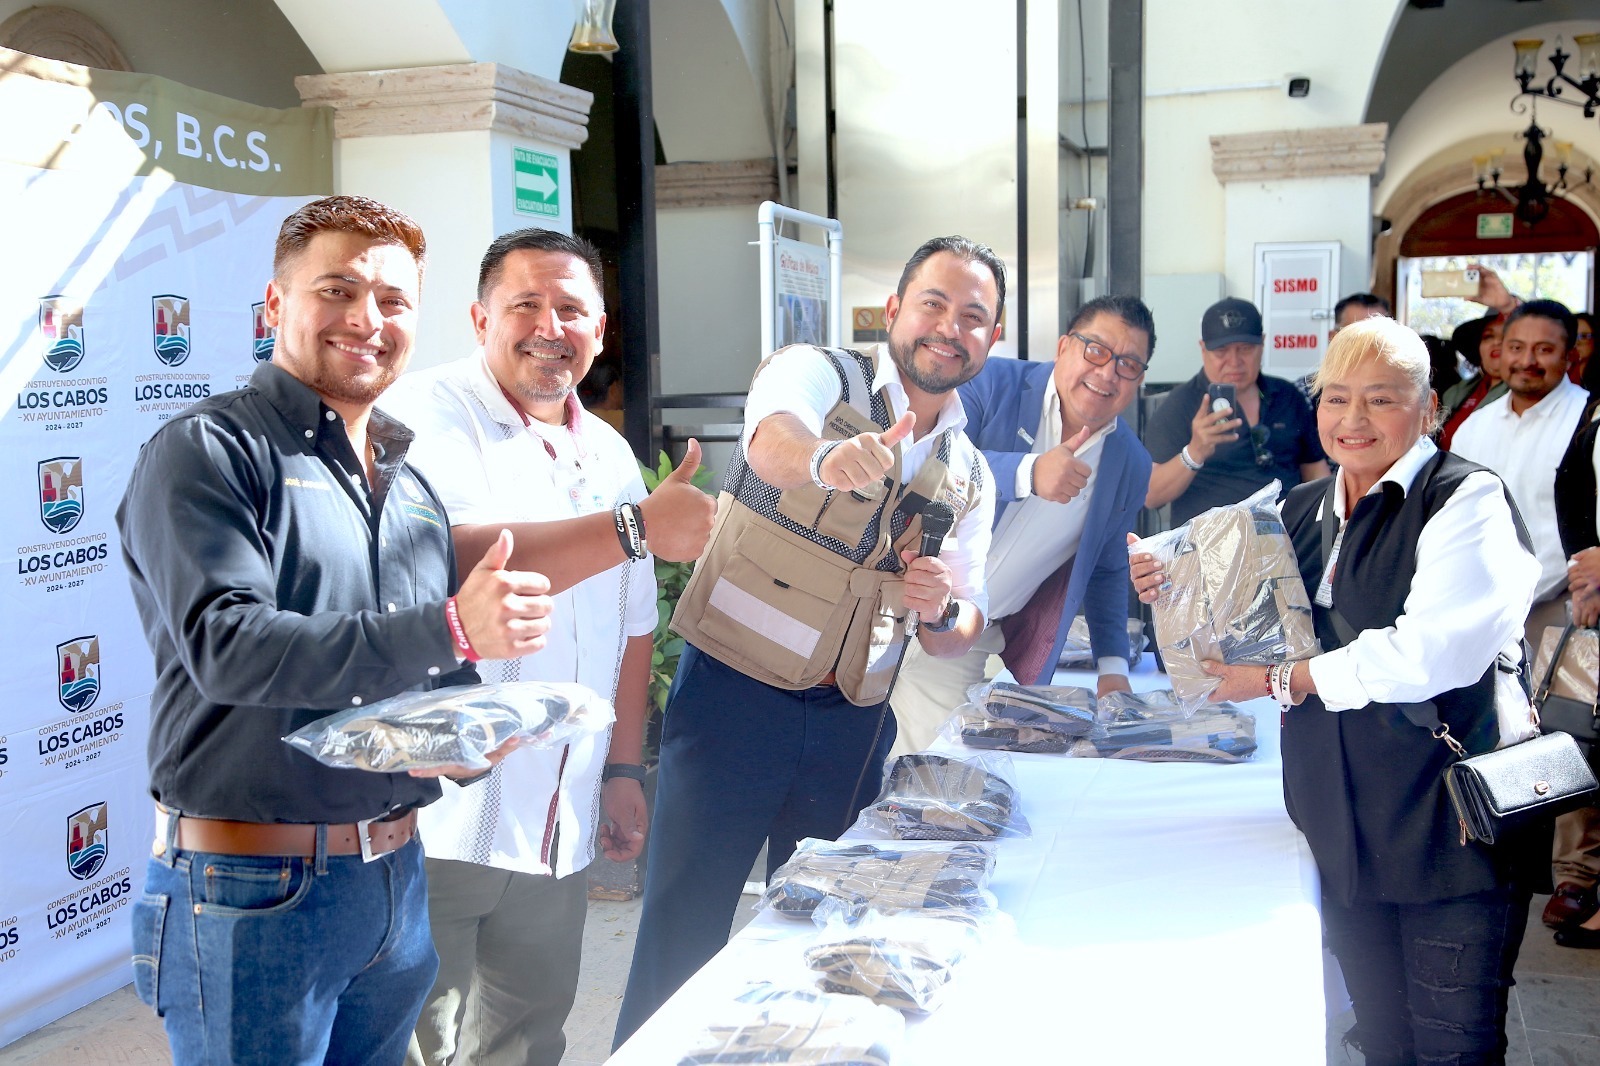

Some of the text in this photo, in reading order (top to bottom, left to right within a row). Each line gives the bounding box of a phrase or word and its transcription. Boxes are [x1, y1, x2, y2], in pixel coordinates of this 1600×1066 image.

[176, 112, 281, 172] B.C.S.
[1274, 278, 1317, 293] SISMO
[1274, 334, 1317, 349] SISMO
[24, 376, 108, 389] NSTRUYENDO CONTIGO
[135, 373, 211, 382] CONSTRUYENDO CONTIGO
[17, 387, 108, 409] LOS CABOS
[135, 383, 211, 402] LOS CABOS
[152, 401, 195, 412] AYUNTAMIE
[17, 532, 107, 555] CONSTRUYENDO CONTIGO
[18, 543, 108, 575] LOS CABOS
[38, 702, 124, 736] CONSTRUYENDO CONTIGO
[39, 712, 124, 756] LOS CABOS
[46, 866, 131, 911] CONSTRUYENDO CONTIGO
[47, 876, 131, 930] LOS CABOS
